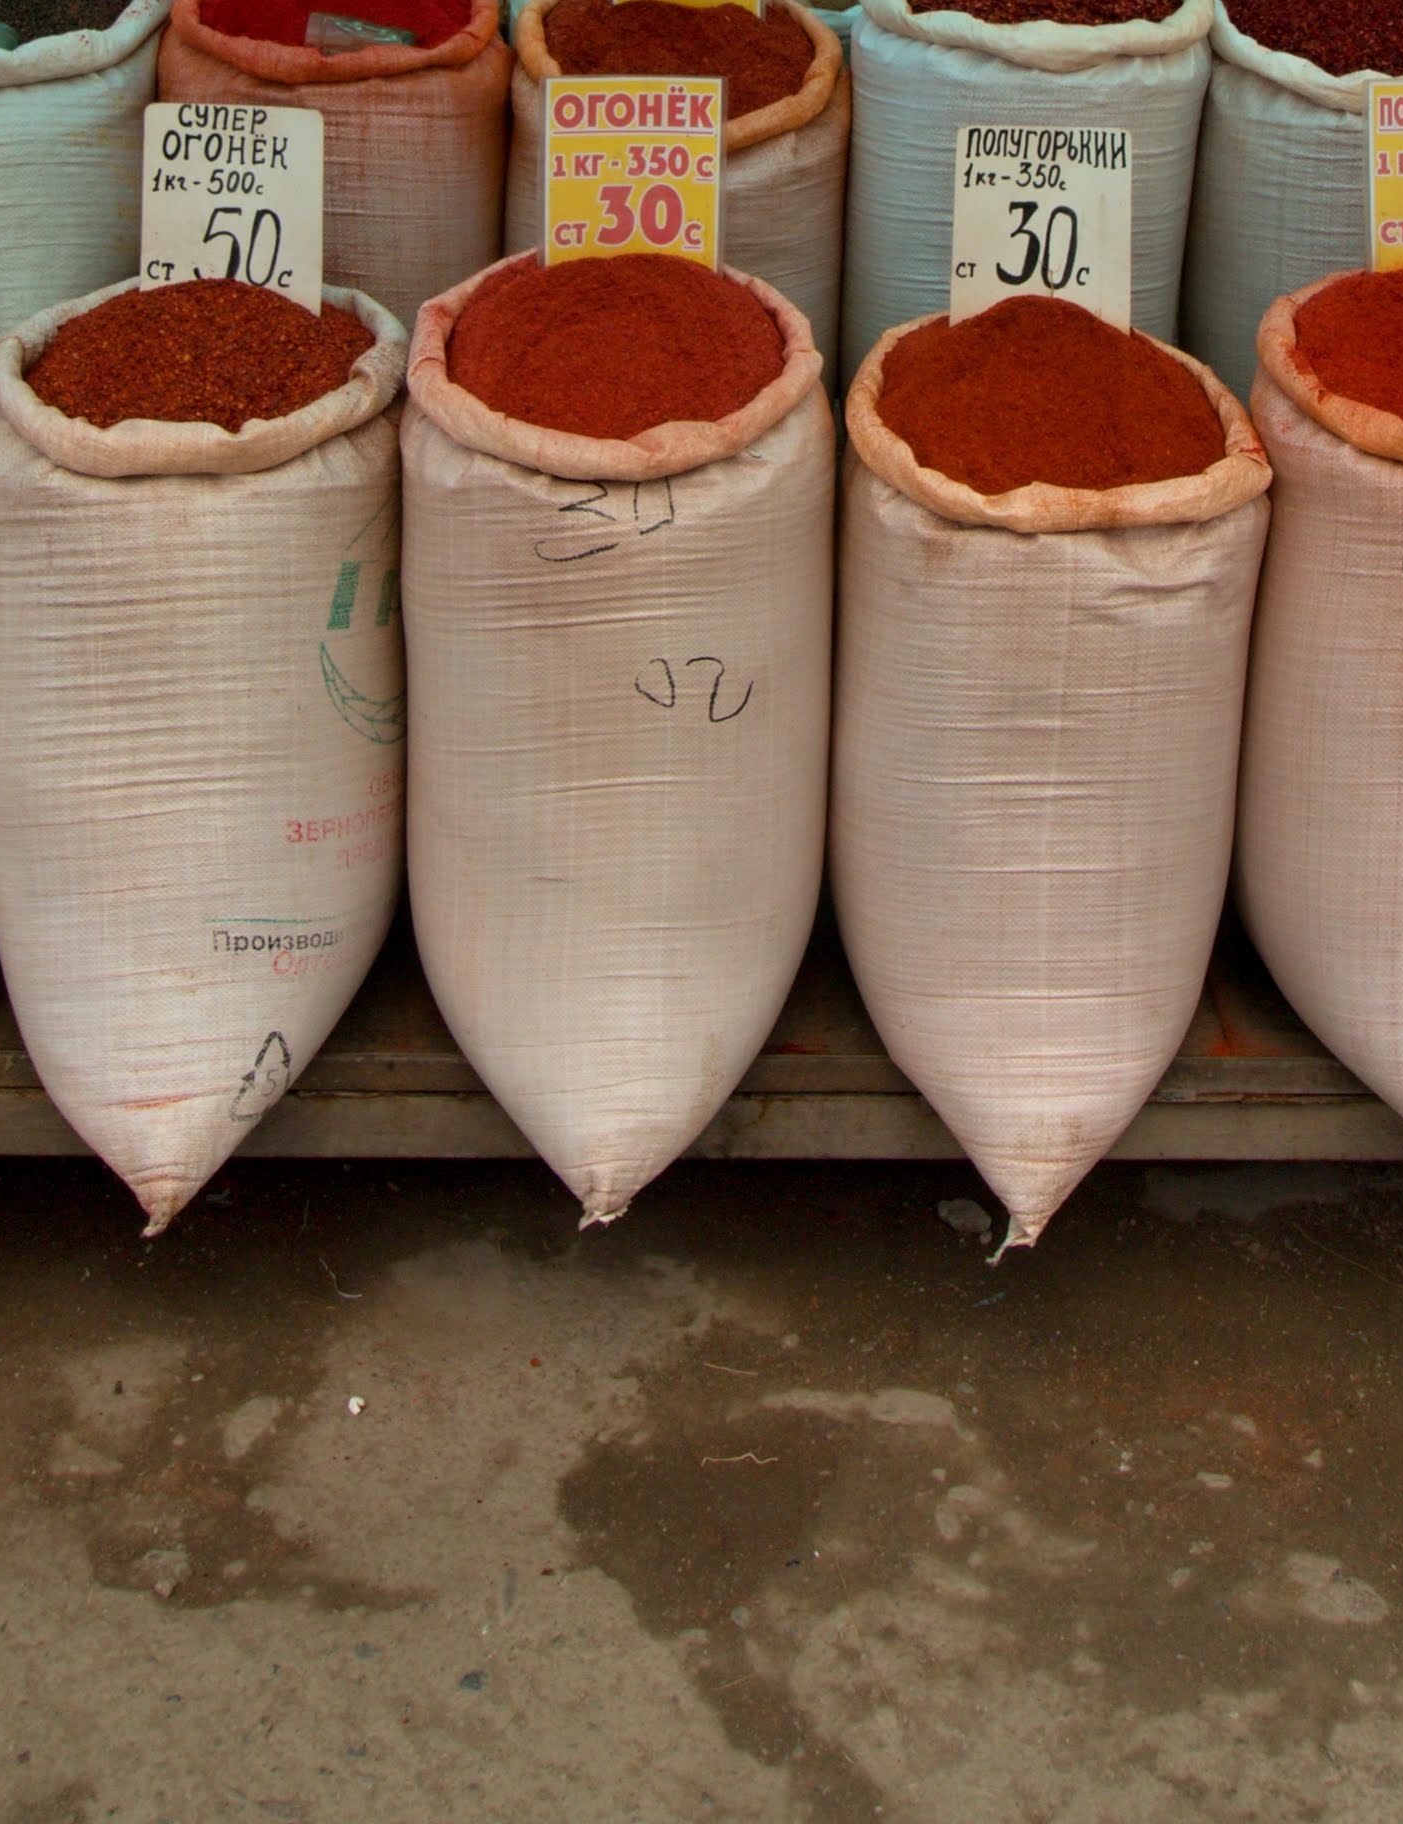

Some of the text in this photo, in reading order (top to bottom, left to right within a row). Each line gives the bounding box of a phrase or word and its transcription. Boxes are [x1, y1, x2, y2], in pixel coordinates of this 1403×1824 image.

[178, 104, 267, 134] СУПЕР
[554, 85, 712, 128] ОГОНЁК
[163, 130, 287, 169] ОГОНЁК
[554, 156, 565, 177] 1
[628, 146, 689, 176] 350
[1378, 153, 1390, 174] 1
[598, 185, 682, 245] 30
[193, 206, 281, 287] 50
[996, 201, 1078, 289] 30
